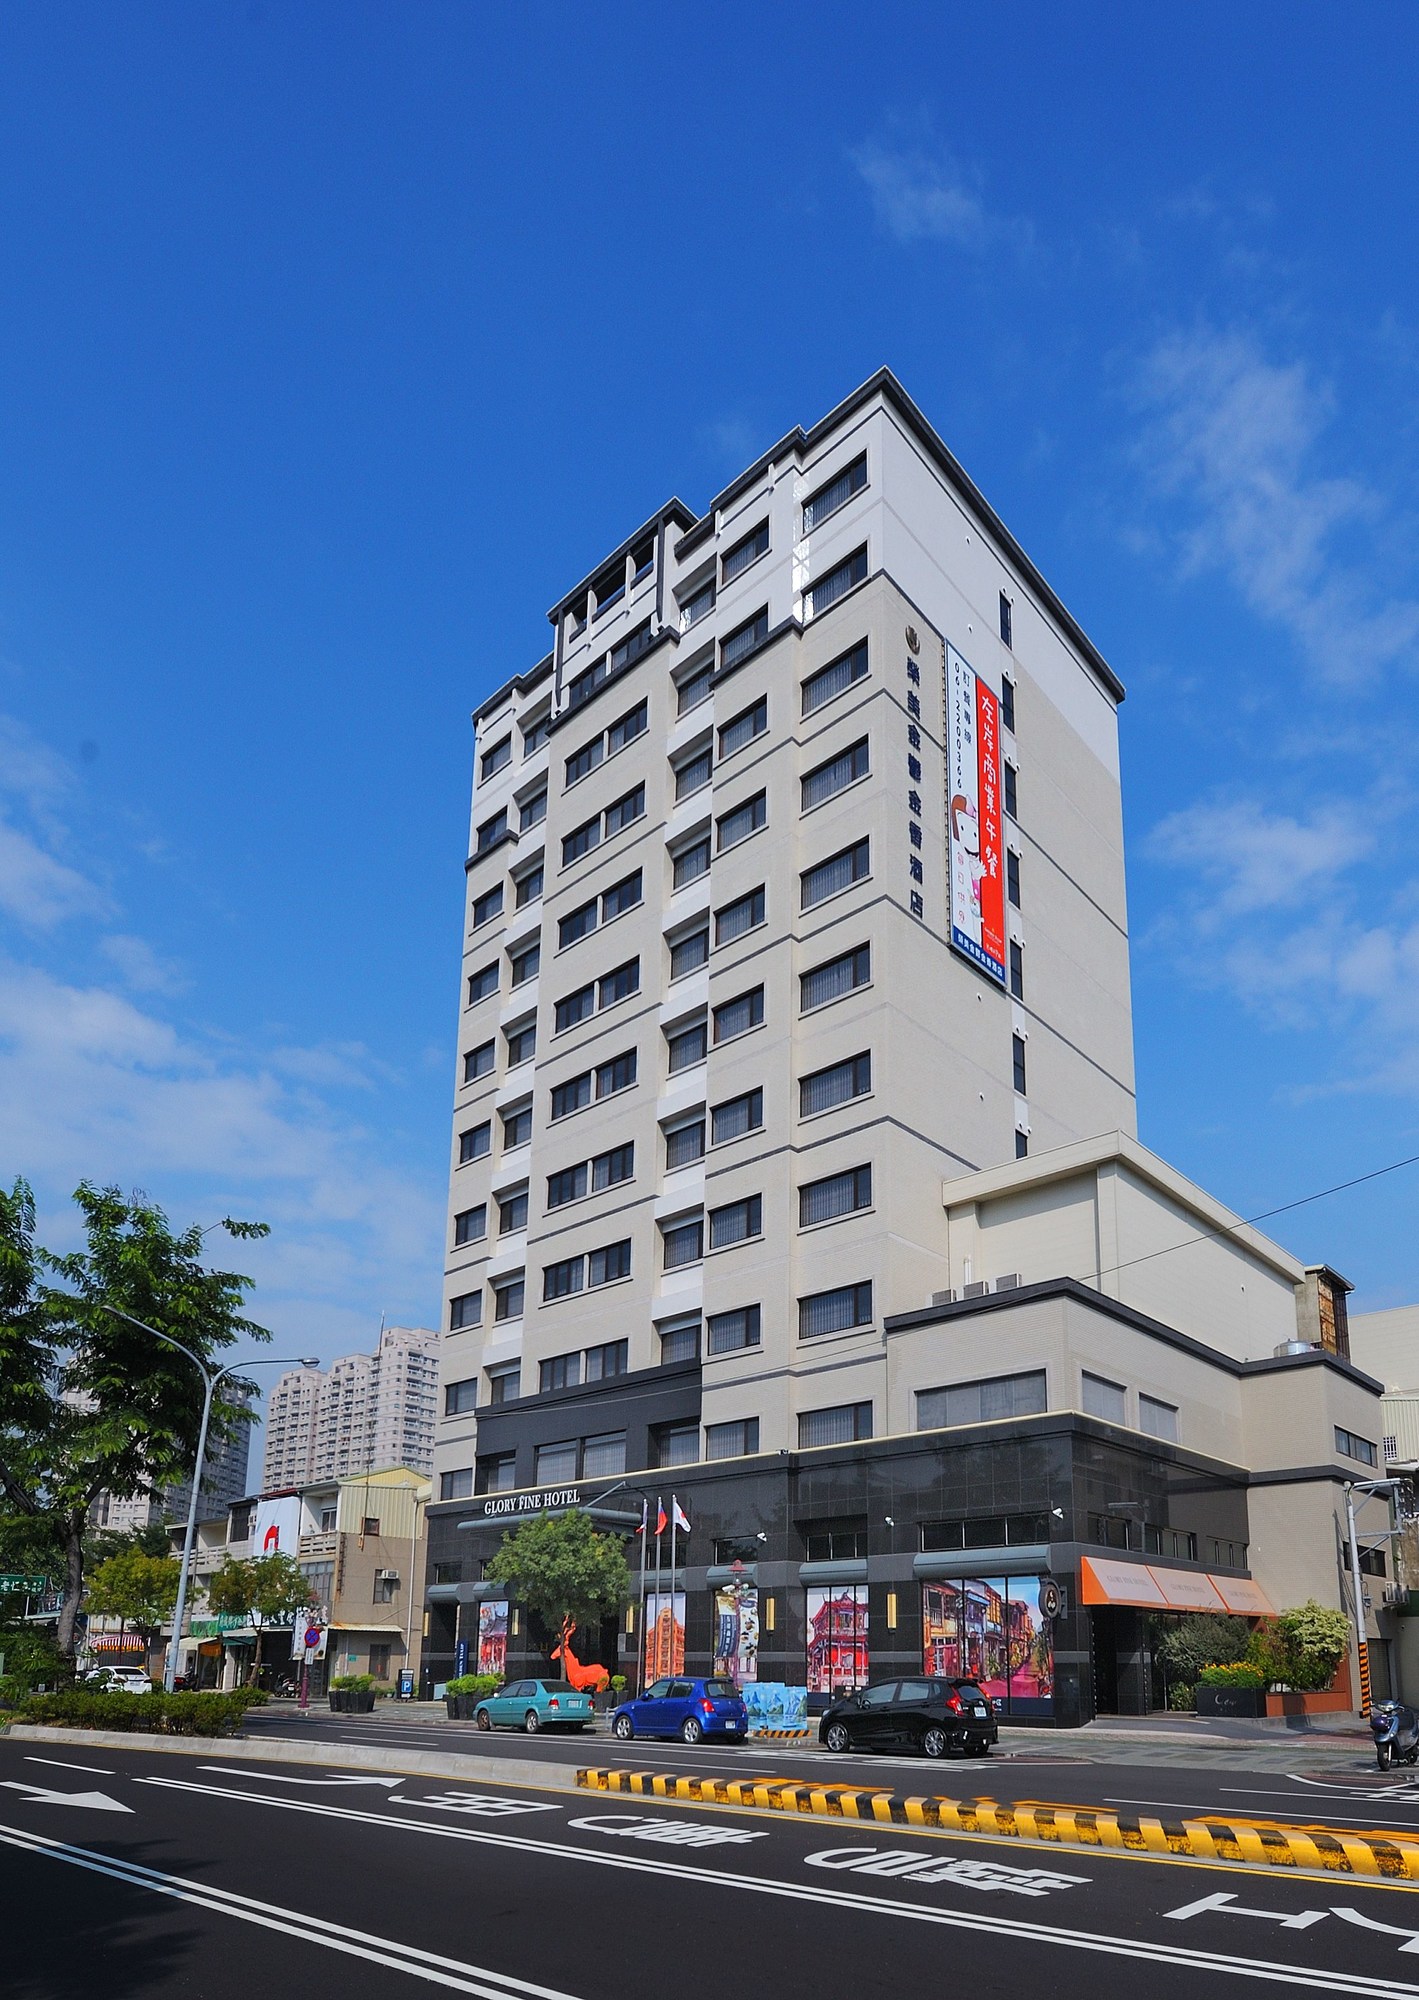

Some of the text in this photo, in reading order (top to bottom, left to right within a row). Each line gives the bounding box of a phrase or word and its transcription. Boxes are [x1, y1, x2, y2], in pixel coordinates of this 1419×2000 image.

[982, 695, 999, 879] 左岸商業午餐
[484, 1488, 581, 1515] GLORY FINE HOTEL
[404, 1681, 410, 1691] P
